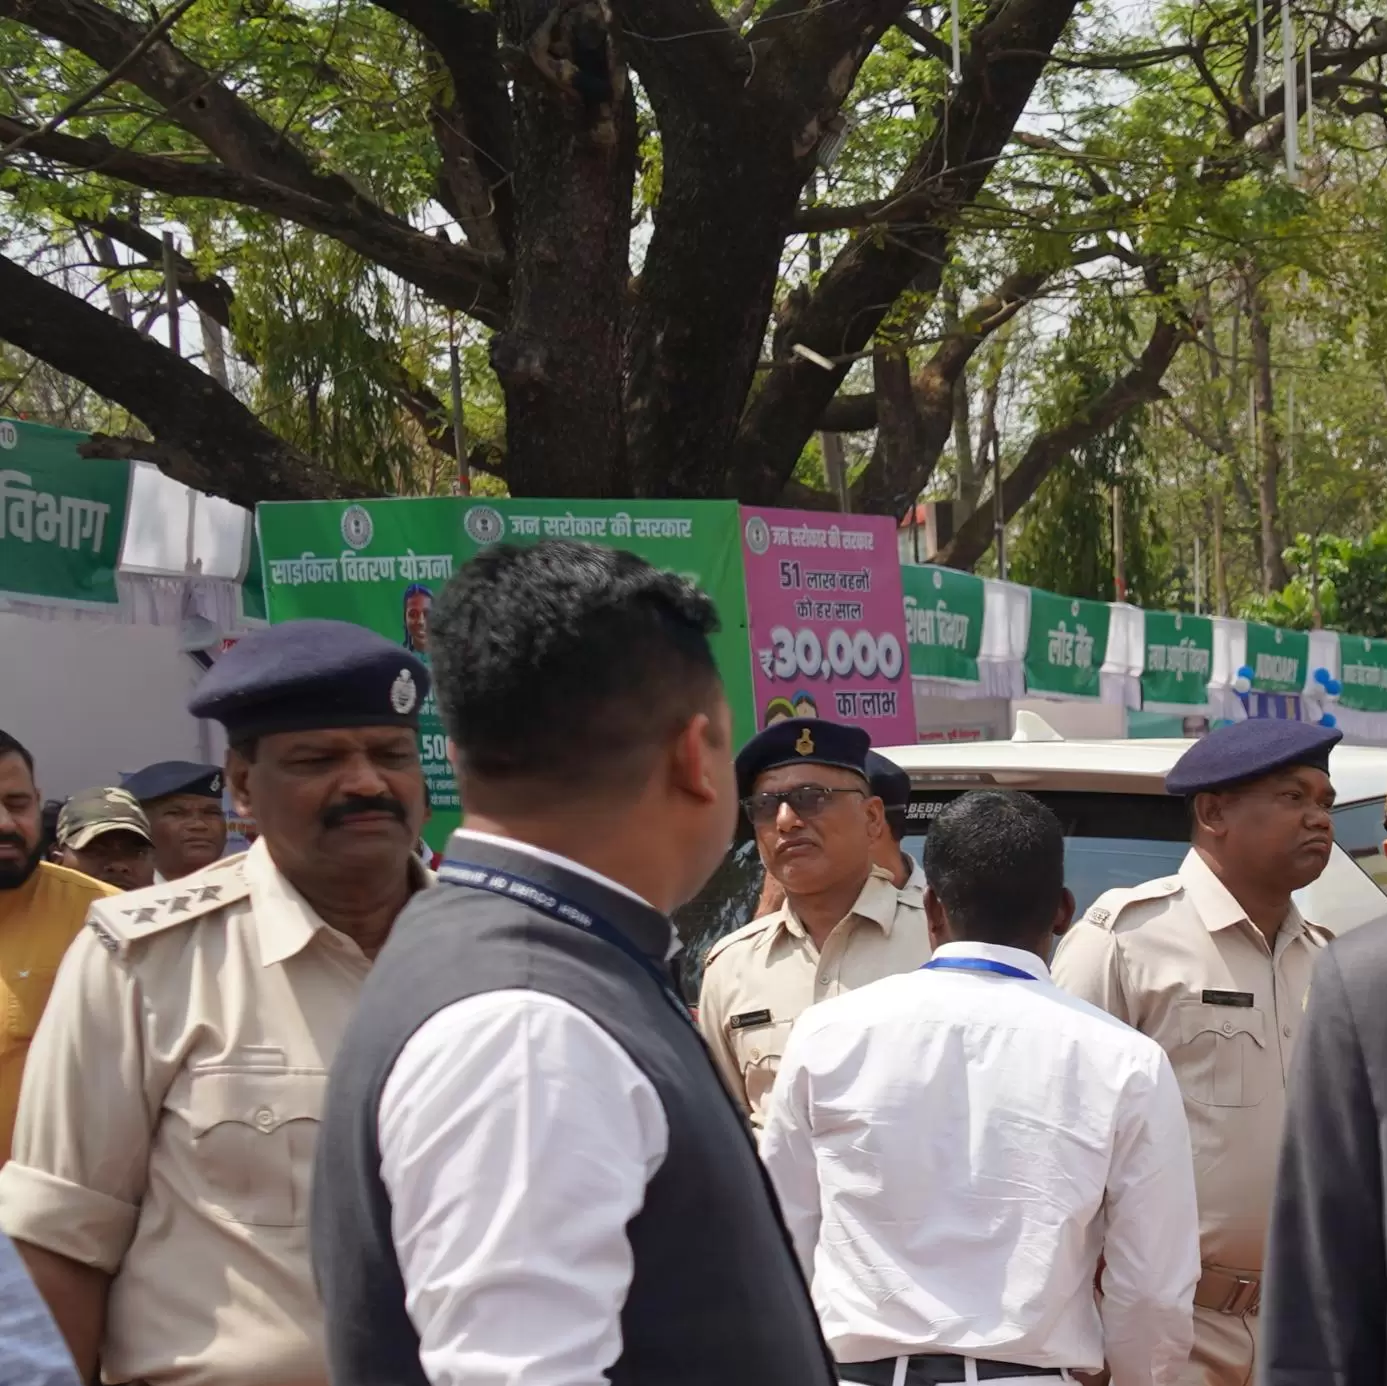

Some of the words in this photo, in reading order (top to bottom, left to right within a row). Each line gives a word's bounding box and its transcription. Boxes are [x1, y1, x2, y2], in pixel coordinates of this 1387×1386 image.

[0, 469, 111, 553] विभाग
[508, 515, 540, 536] जन
[543, 511, 607, 537] सरोकार
[609, 511, 632, 537] की
[634, 517, 693, 538] सरकार
[770, 526, 790, 546] जन
[791, 524, 827, 548] सरोकार
[828, 525, 841, 549] की
[841, 531, 874, 550] सरकार
[269, 552, 338, 586] साइकिल
[340, 550, 396, 582] वितरण
[397, 548, 453, 581] योजना
[780, 561, 800, 588] 51
[806, 571, 836, 590] लाख
[839, 567, 870, 591] बहनों
[797, 596, 812, 618] को
[815, 602, 833, 618] हर
[834, 602, 862, 619] साल
[759, 626, 904, 681] ₹30,000
[1048, 620, 1074, 667] लीड
[1254, 652, 1299, 683] JUDICIARY
[835, 691, 858, 717] का
[860, 691, 897, 717] लाभ
